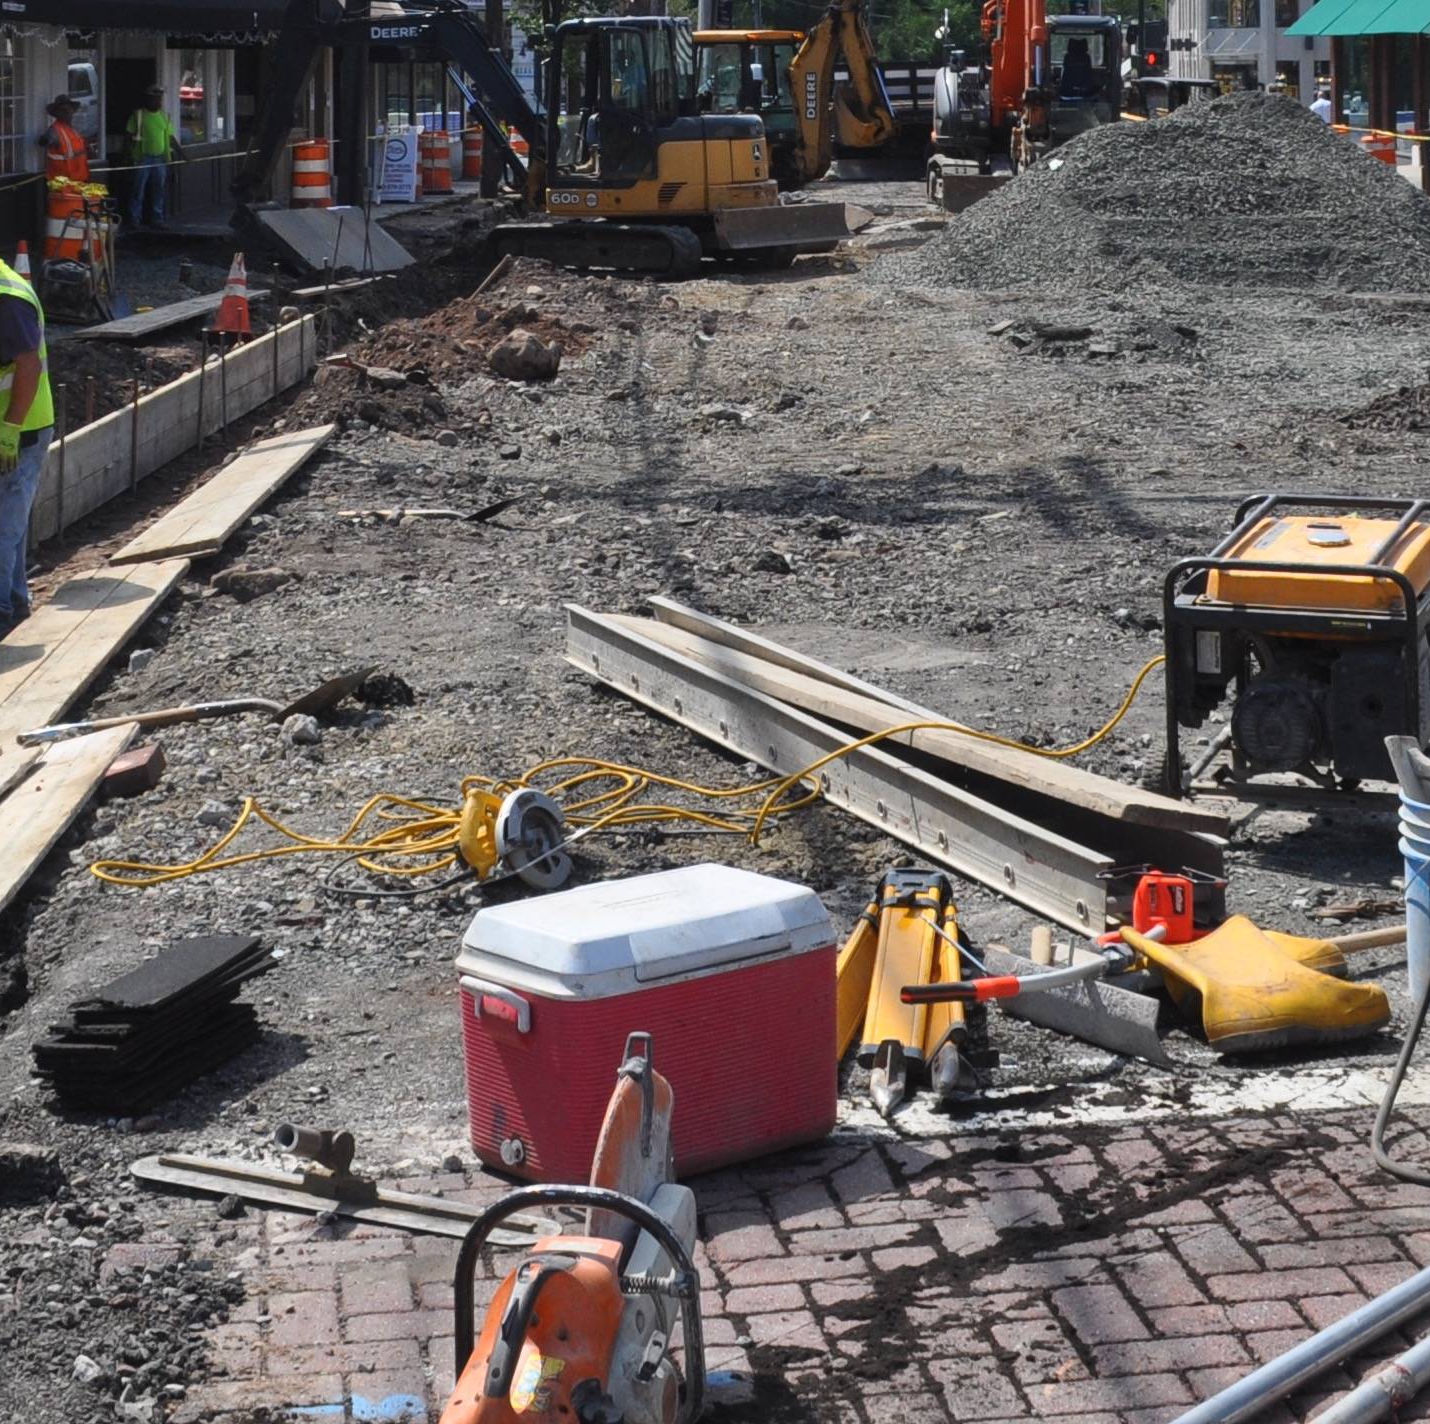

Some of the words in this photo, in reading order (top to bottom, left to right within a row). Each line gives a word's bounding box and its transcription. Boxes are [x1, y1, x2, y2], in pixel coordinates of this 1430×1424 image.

[371, 26, 419, 40] DEERE
[806, 72, 817, 120] DEERE
[550, 192, 580, 205] 60D
